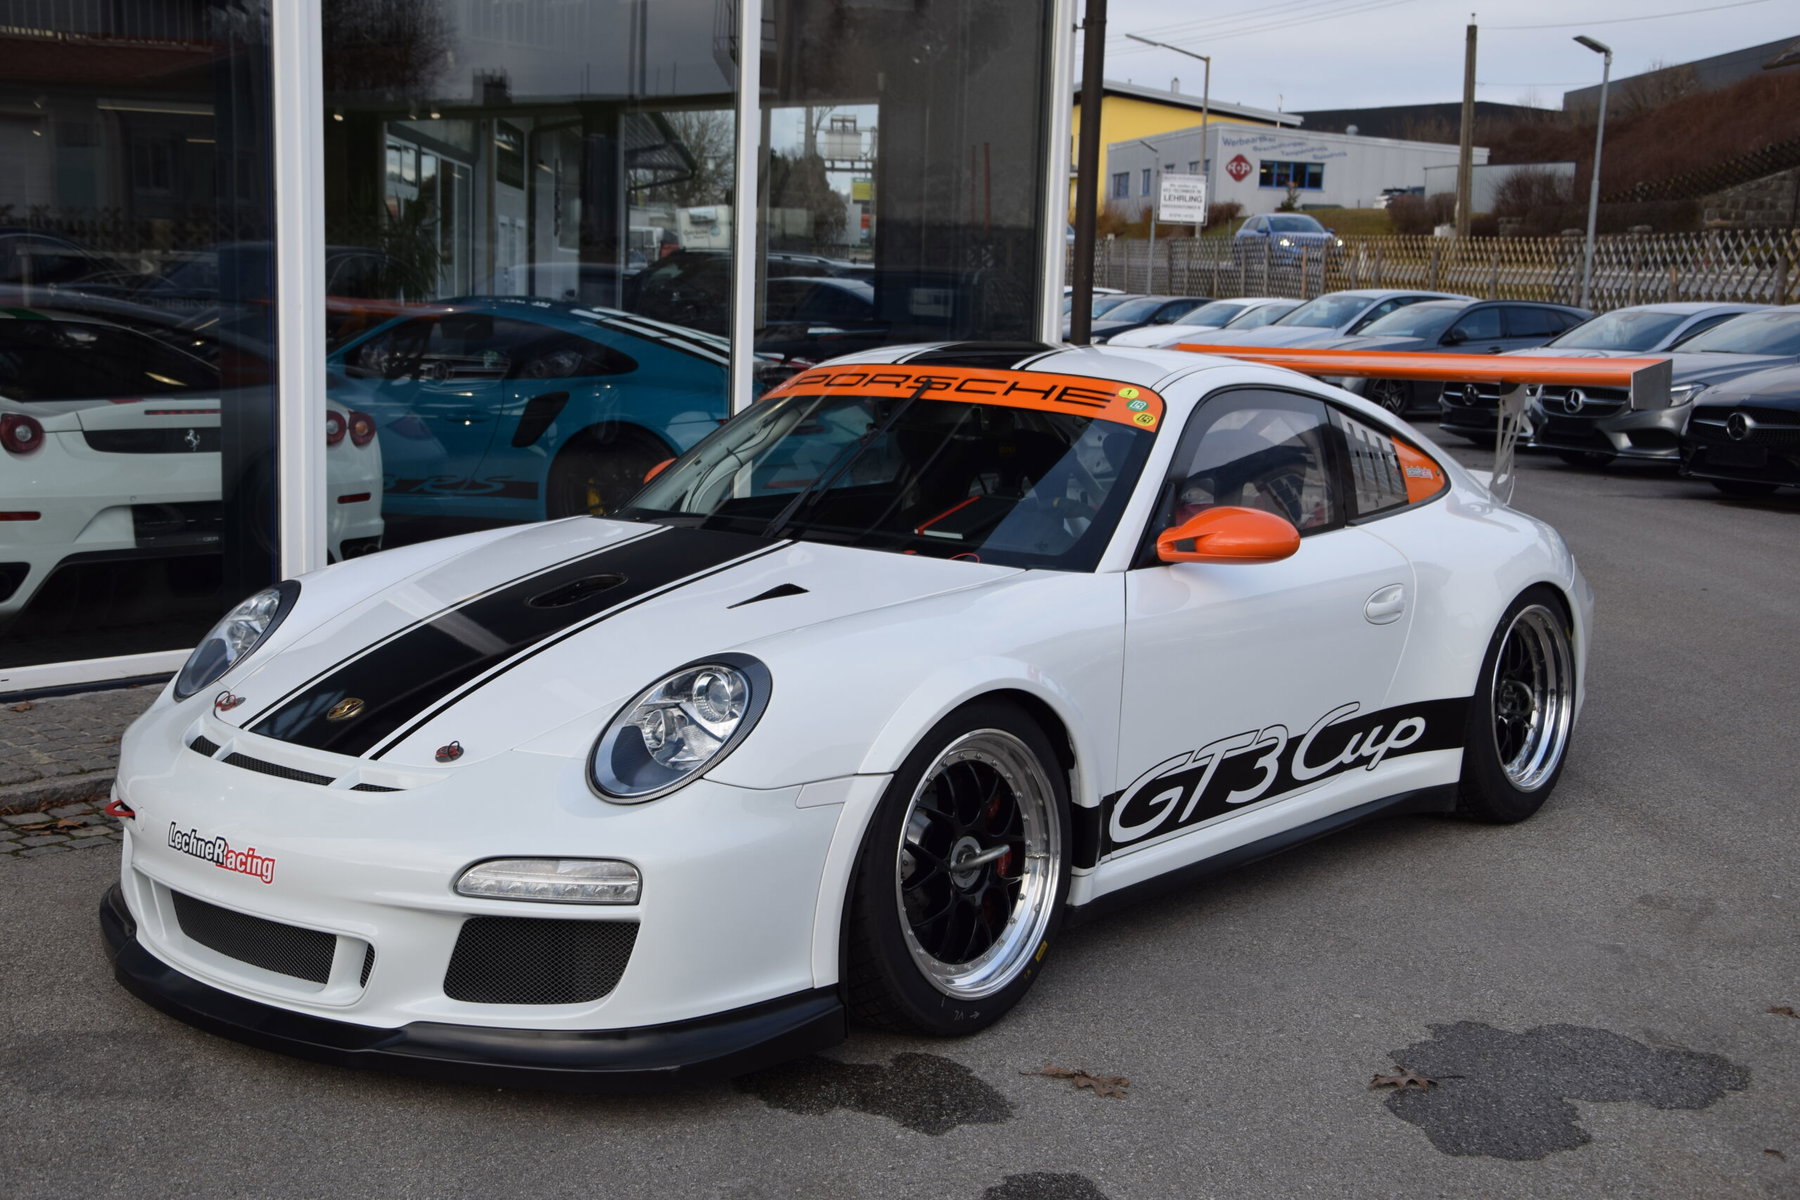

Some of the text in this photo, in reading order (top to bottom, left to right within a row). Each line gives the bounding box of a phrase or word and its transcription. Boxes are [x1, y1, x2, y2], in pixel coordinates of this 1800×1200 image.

[1163, 194, 1203, 204] LEHRLING
[788, 373, 1118, 409] PORSCHE
[1109, 700, 1426, 843] GT3 Cup
